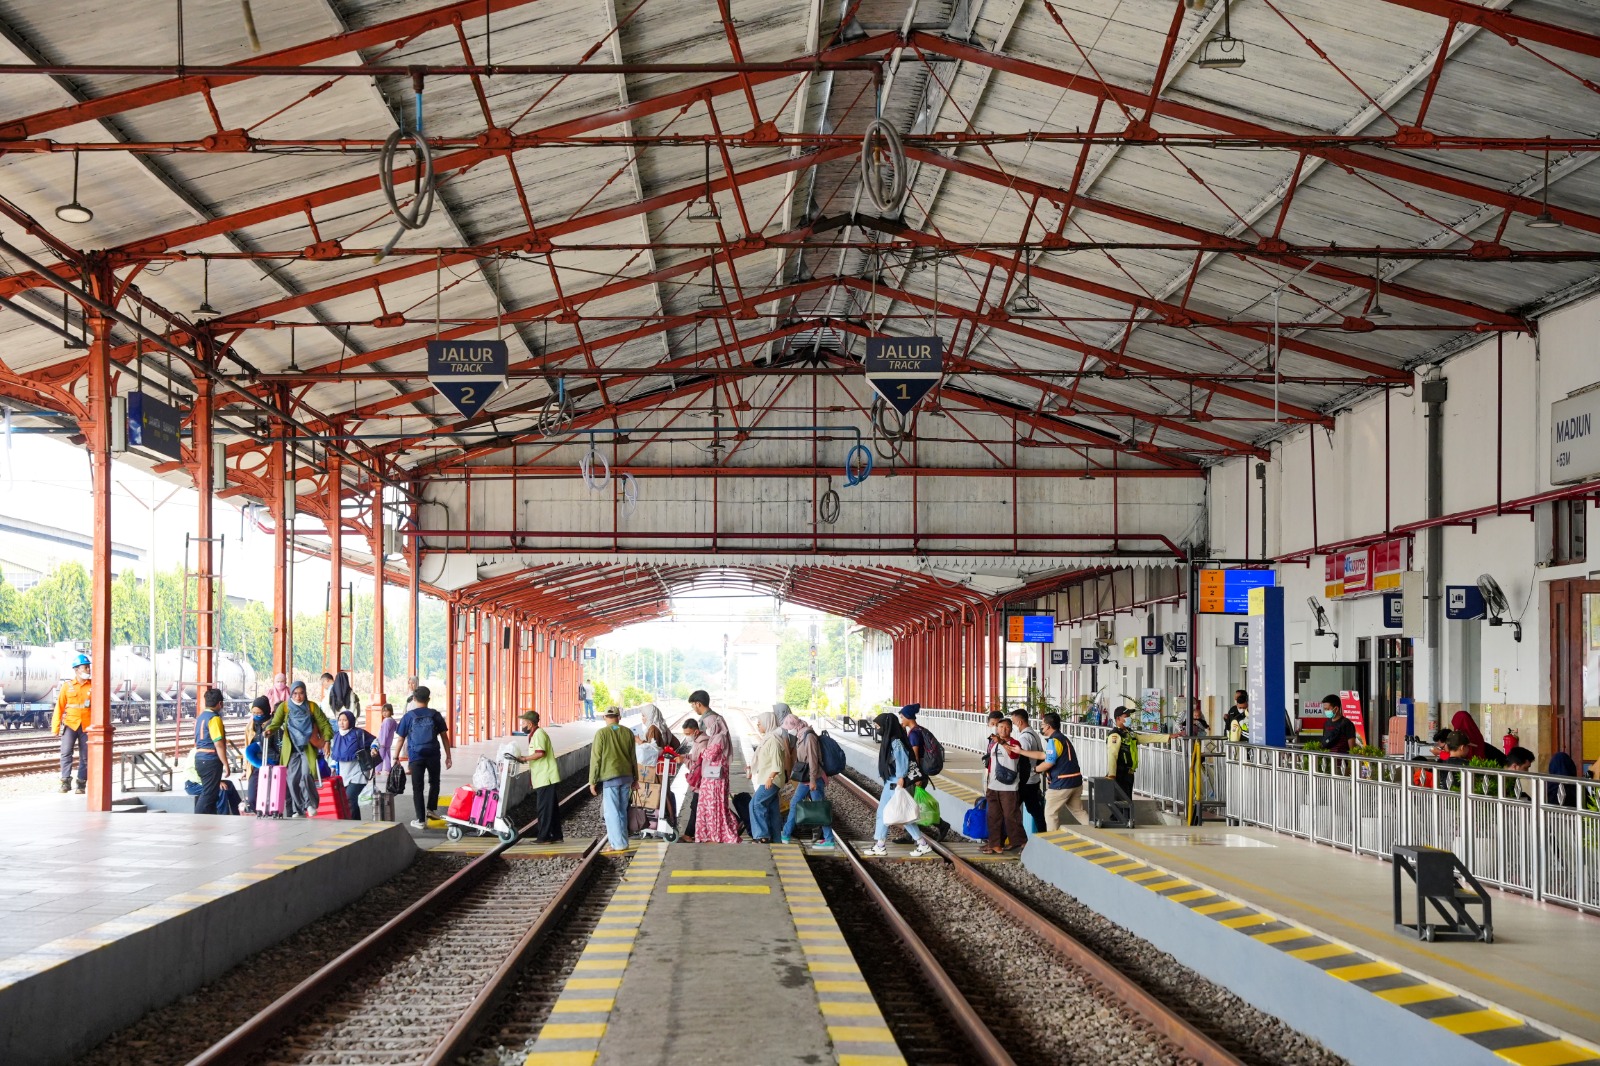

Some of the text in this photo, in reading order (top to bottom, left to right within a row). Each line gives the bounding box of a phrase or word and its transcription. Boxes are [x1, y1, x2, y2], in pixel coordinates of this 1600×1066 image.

[438, 347, 494, 362] JALUR
[877, 345, 932, 359] JALUR
[450, 363, 484, 373] TRACK
[889, 360, 921, 370] TRACK
[460, 386, 476, 404] 2
[896, 383, 911, 400] 1
[1556, 412, 1591, 444] MADIUN
